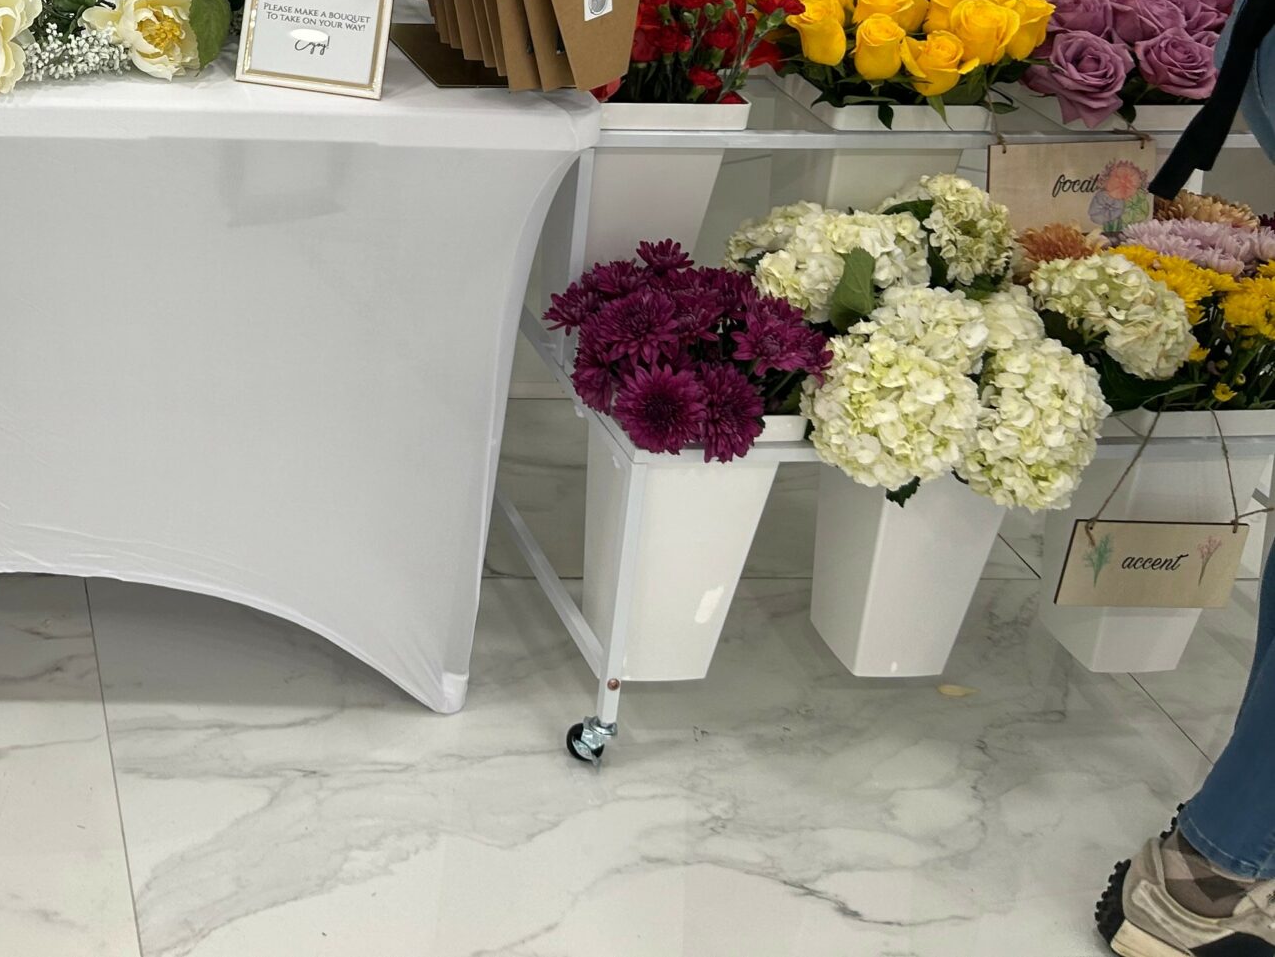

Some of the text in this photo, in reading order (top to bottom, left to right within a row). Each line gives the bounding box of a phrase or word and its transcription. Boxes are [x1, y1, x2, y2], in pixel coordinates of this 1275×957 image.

[263, 1, 293, 13] PLEASE
[294, 8, 319, 17] MAKE
[328, 12, 372, 24] BOUQUET
[266, 11, 366, 32] TO TAKE ON YOUR WAY!
[1052, 174, 1101, 198] focal
[1121, 554, 1189, 571] accent
